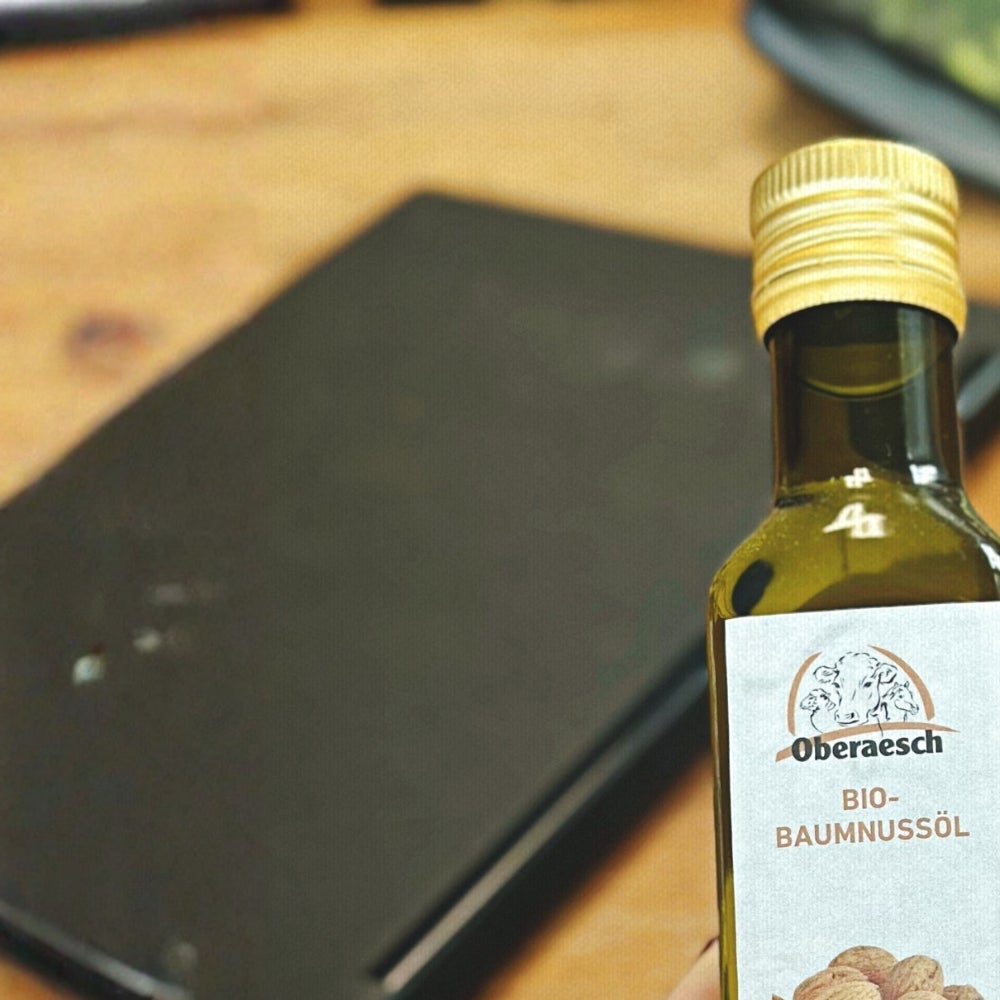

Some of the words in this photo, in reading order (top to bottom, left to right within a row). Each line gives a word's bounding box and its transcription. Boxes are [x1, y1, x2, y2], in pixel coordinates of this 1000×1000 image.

[791, 729, 943, 762] Oberaesch
[842, 786, 900, 811] BIO-
[775, 811, 970, 848] BAUMNUSSÖL
